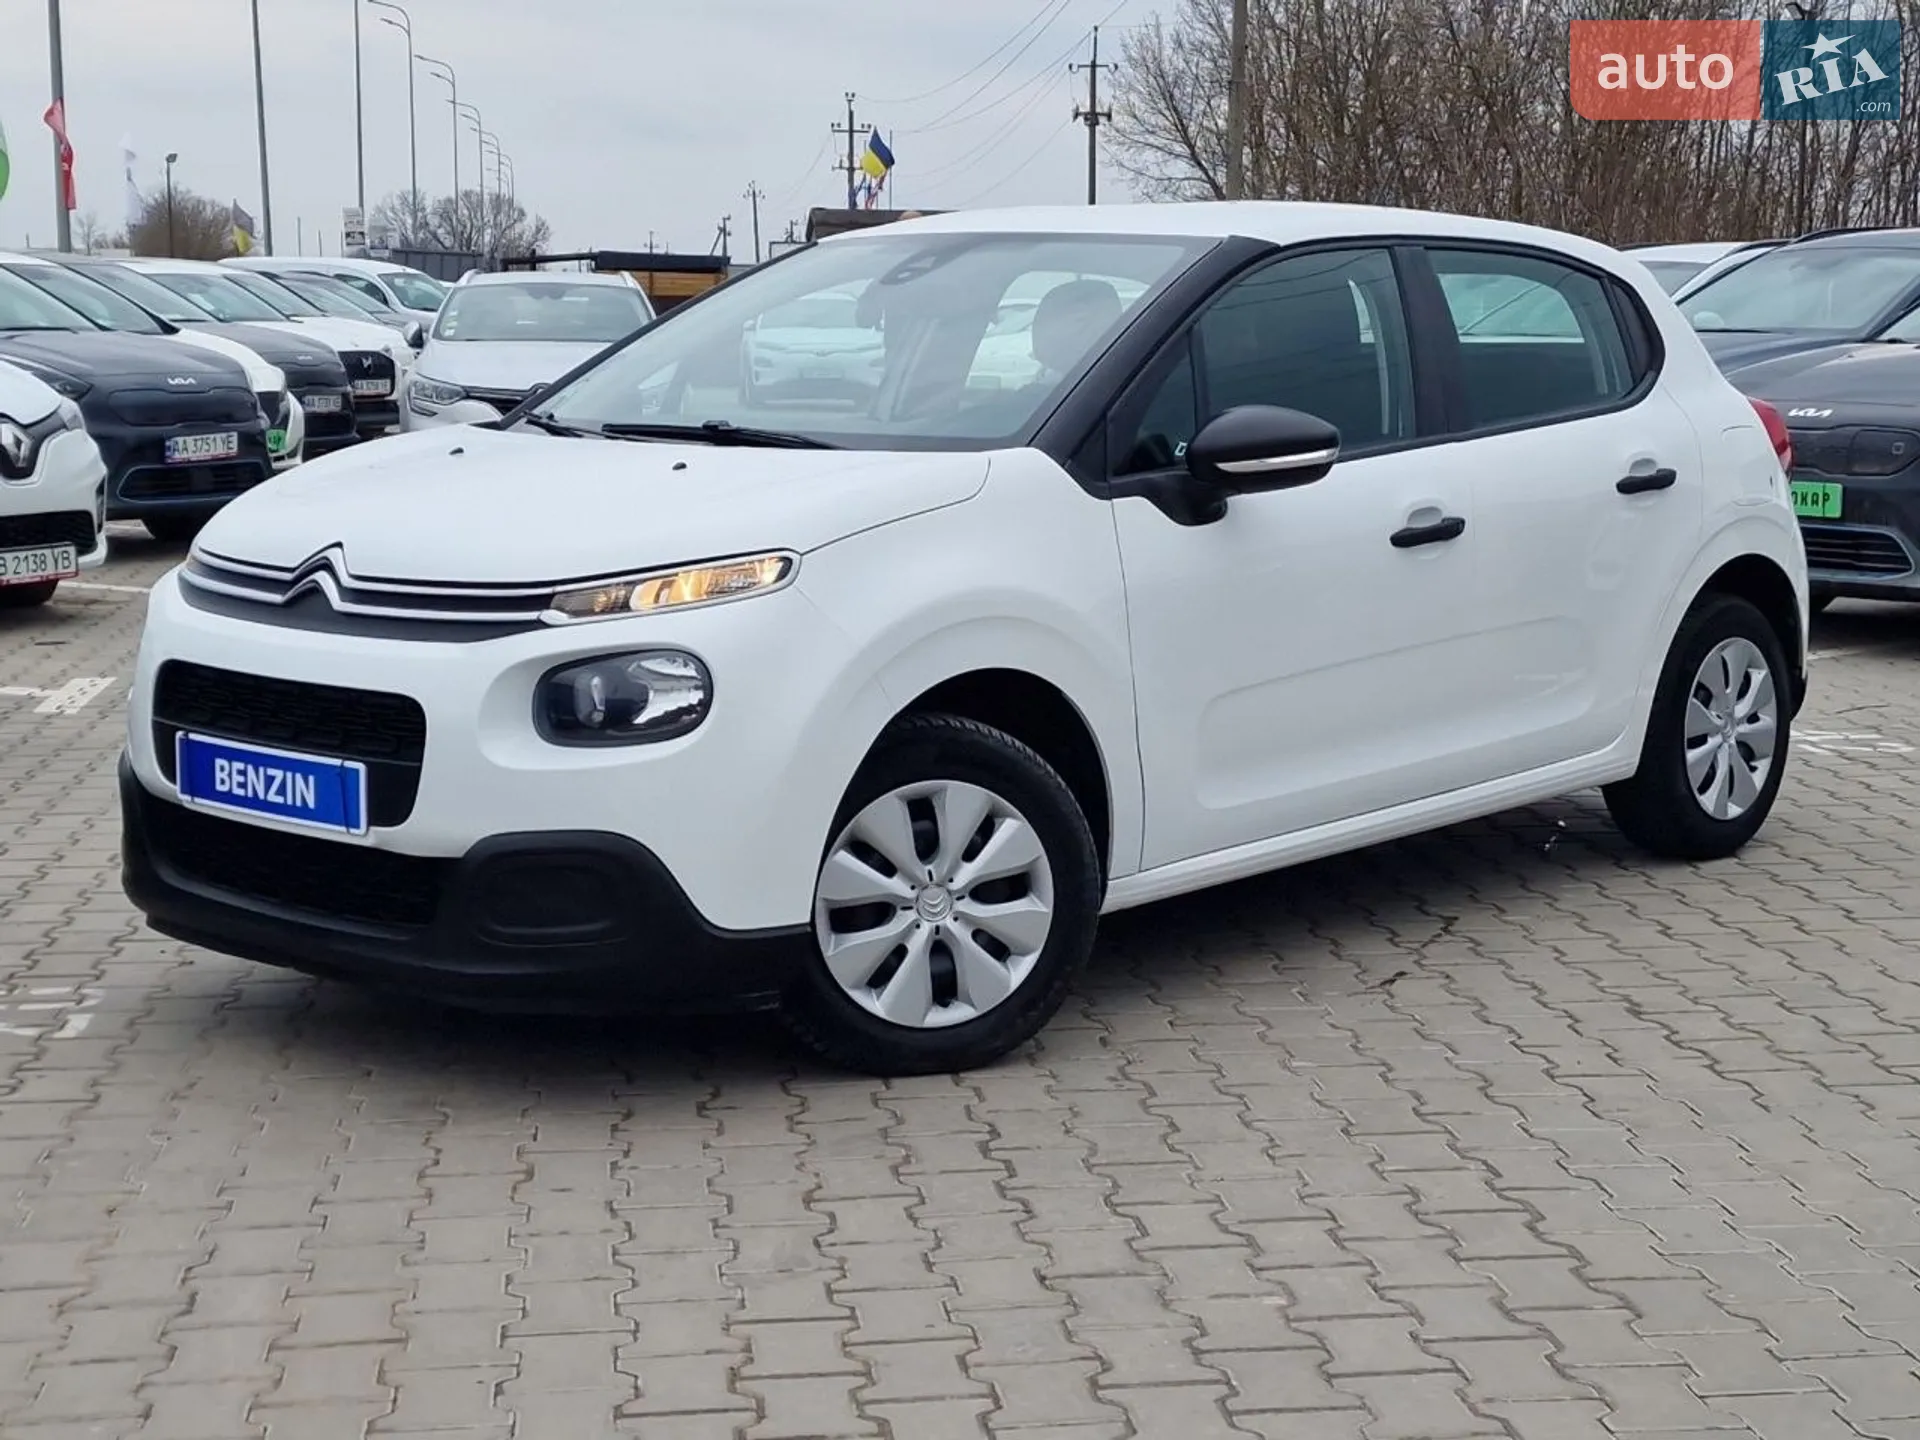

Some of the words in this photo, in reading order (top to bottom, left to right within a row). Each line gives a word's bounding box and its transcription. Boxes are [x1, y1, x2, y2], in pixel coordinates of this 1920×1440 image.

[192, 436, 218, 453] 3751
[12, 551, 48, 576] 2138
[51, 547, 72, 571] YB
[214, 757, 316, 810] BENZIN
